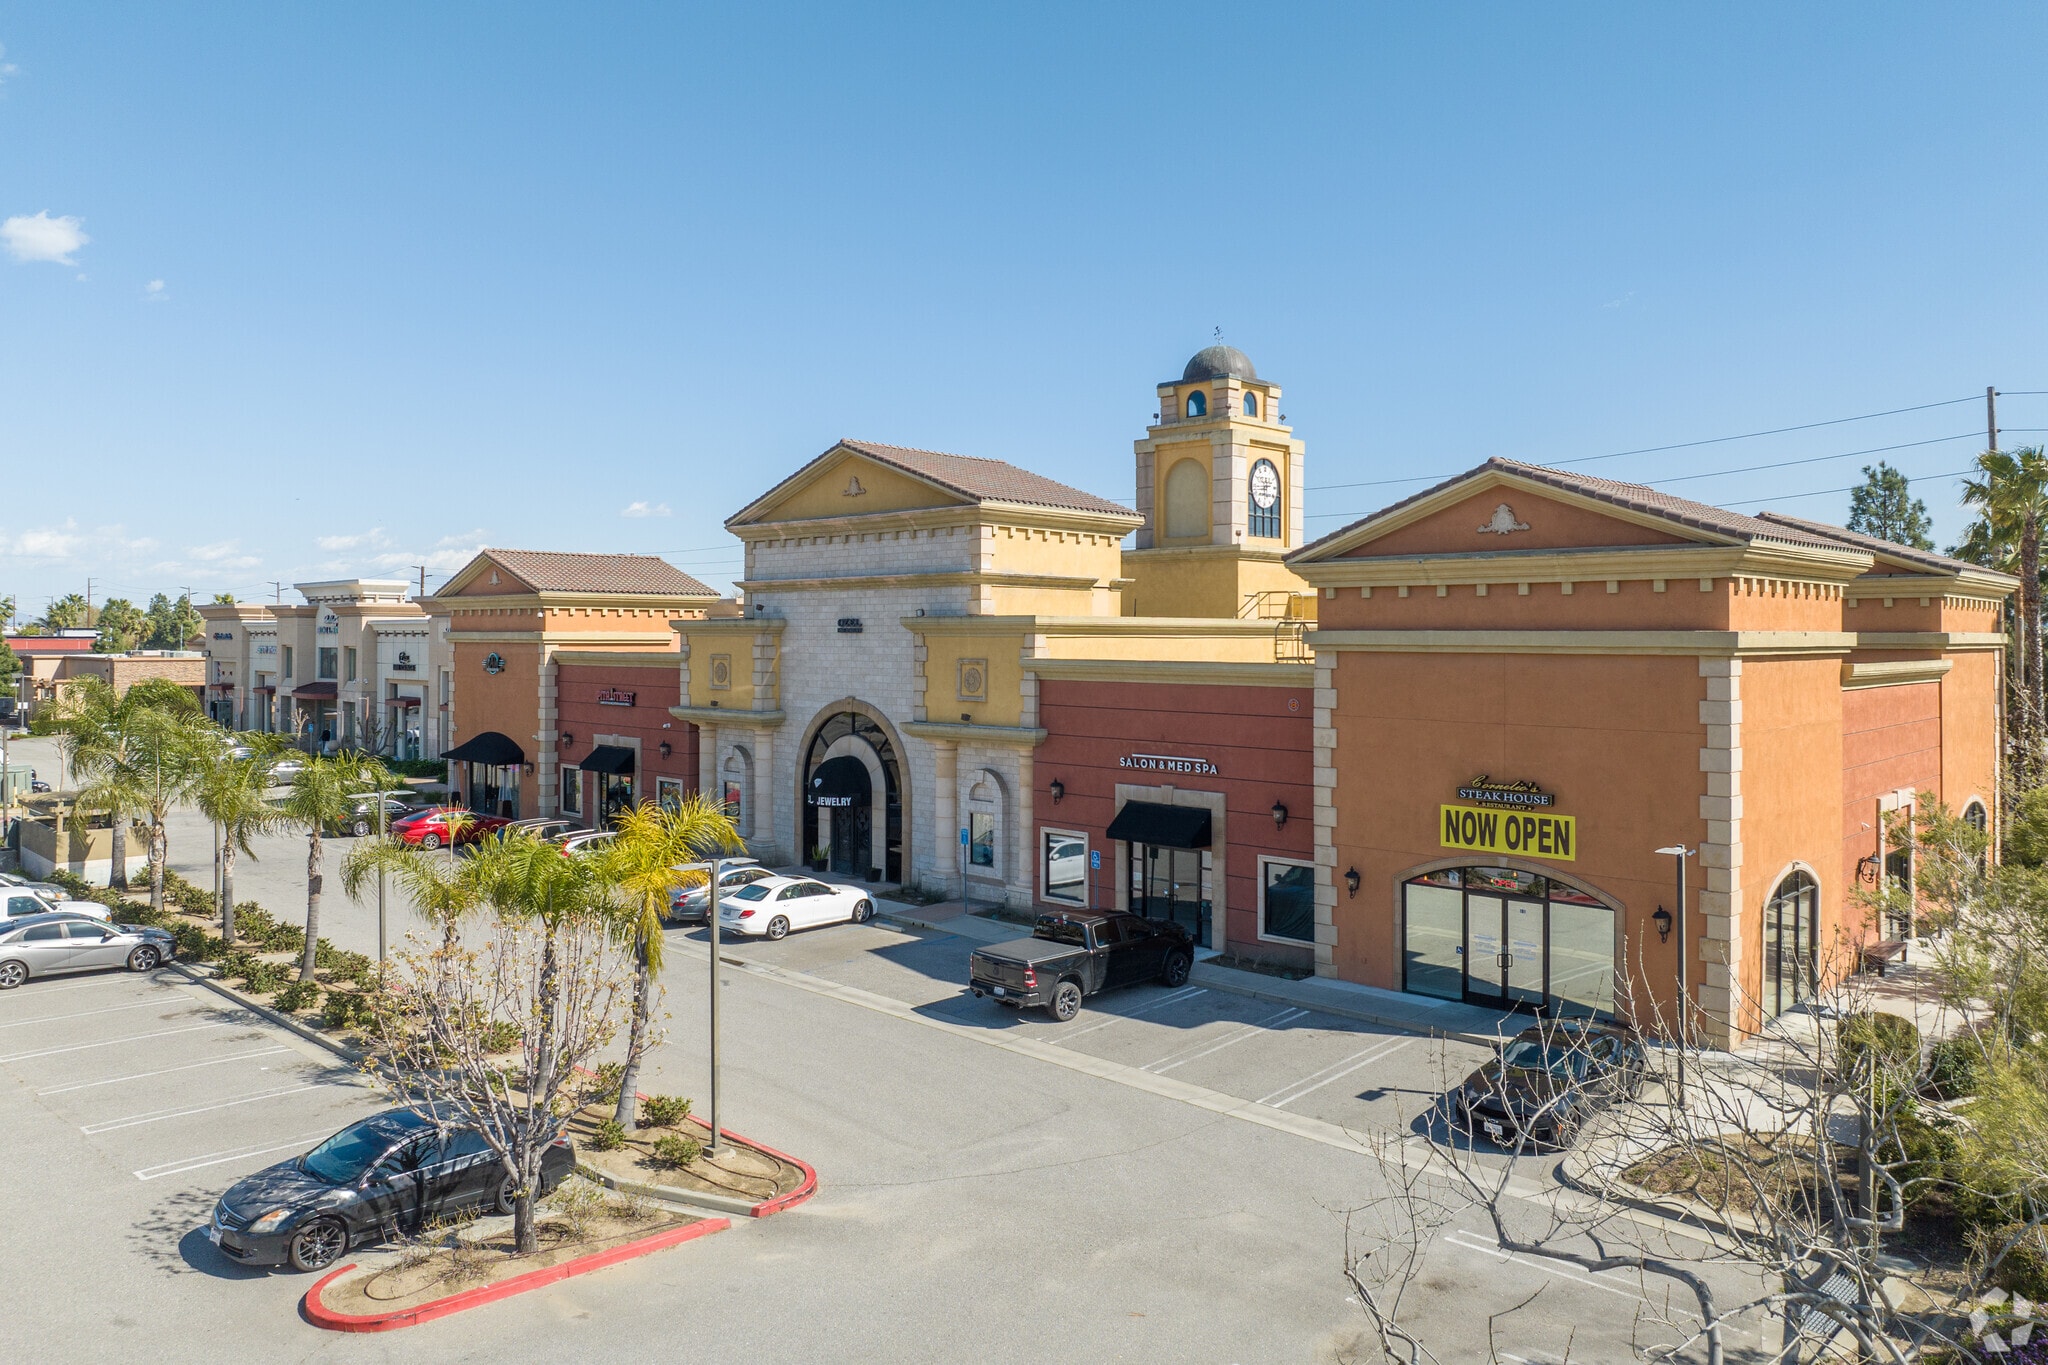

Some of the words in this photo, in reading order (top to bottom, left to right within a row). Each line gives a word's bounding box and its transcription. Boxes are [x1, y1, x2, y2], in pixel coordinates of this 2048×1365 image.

[1119, 757, 1156, 769] SALON
[1159, 760, 1165, 770] &
[1167, 760, 1192, 772] MED
[1195, 763, 1218, 775] SPA
[1471, 775, 1539, 793] Cornelio's
[816, 796, 851, 807] JEWELRY
[1459, 789, 1501, 801] STEAK
[1503, 792, 1549, 805] HOUSE
[1482, 801, 1527, 811] RESTAURANT
[1445, 809, 1498, 847] NOW
[1504, 815, 1570, 856] OPEN
[1493, 877, 1517, 889] OPEN
